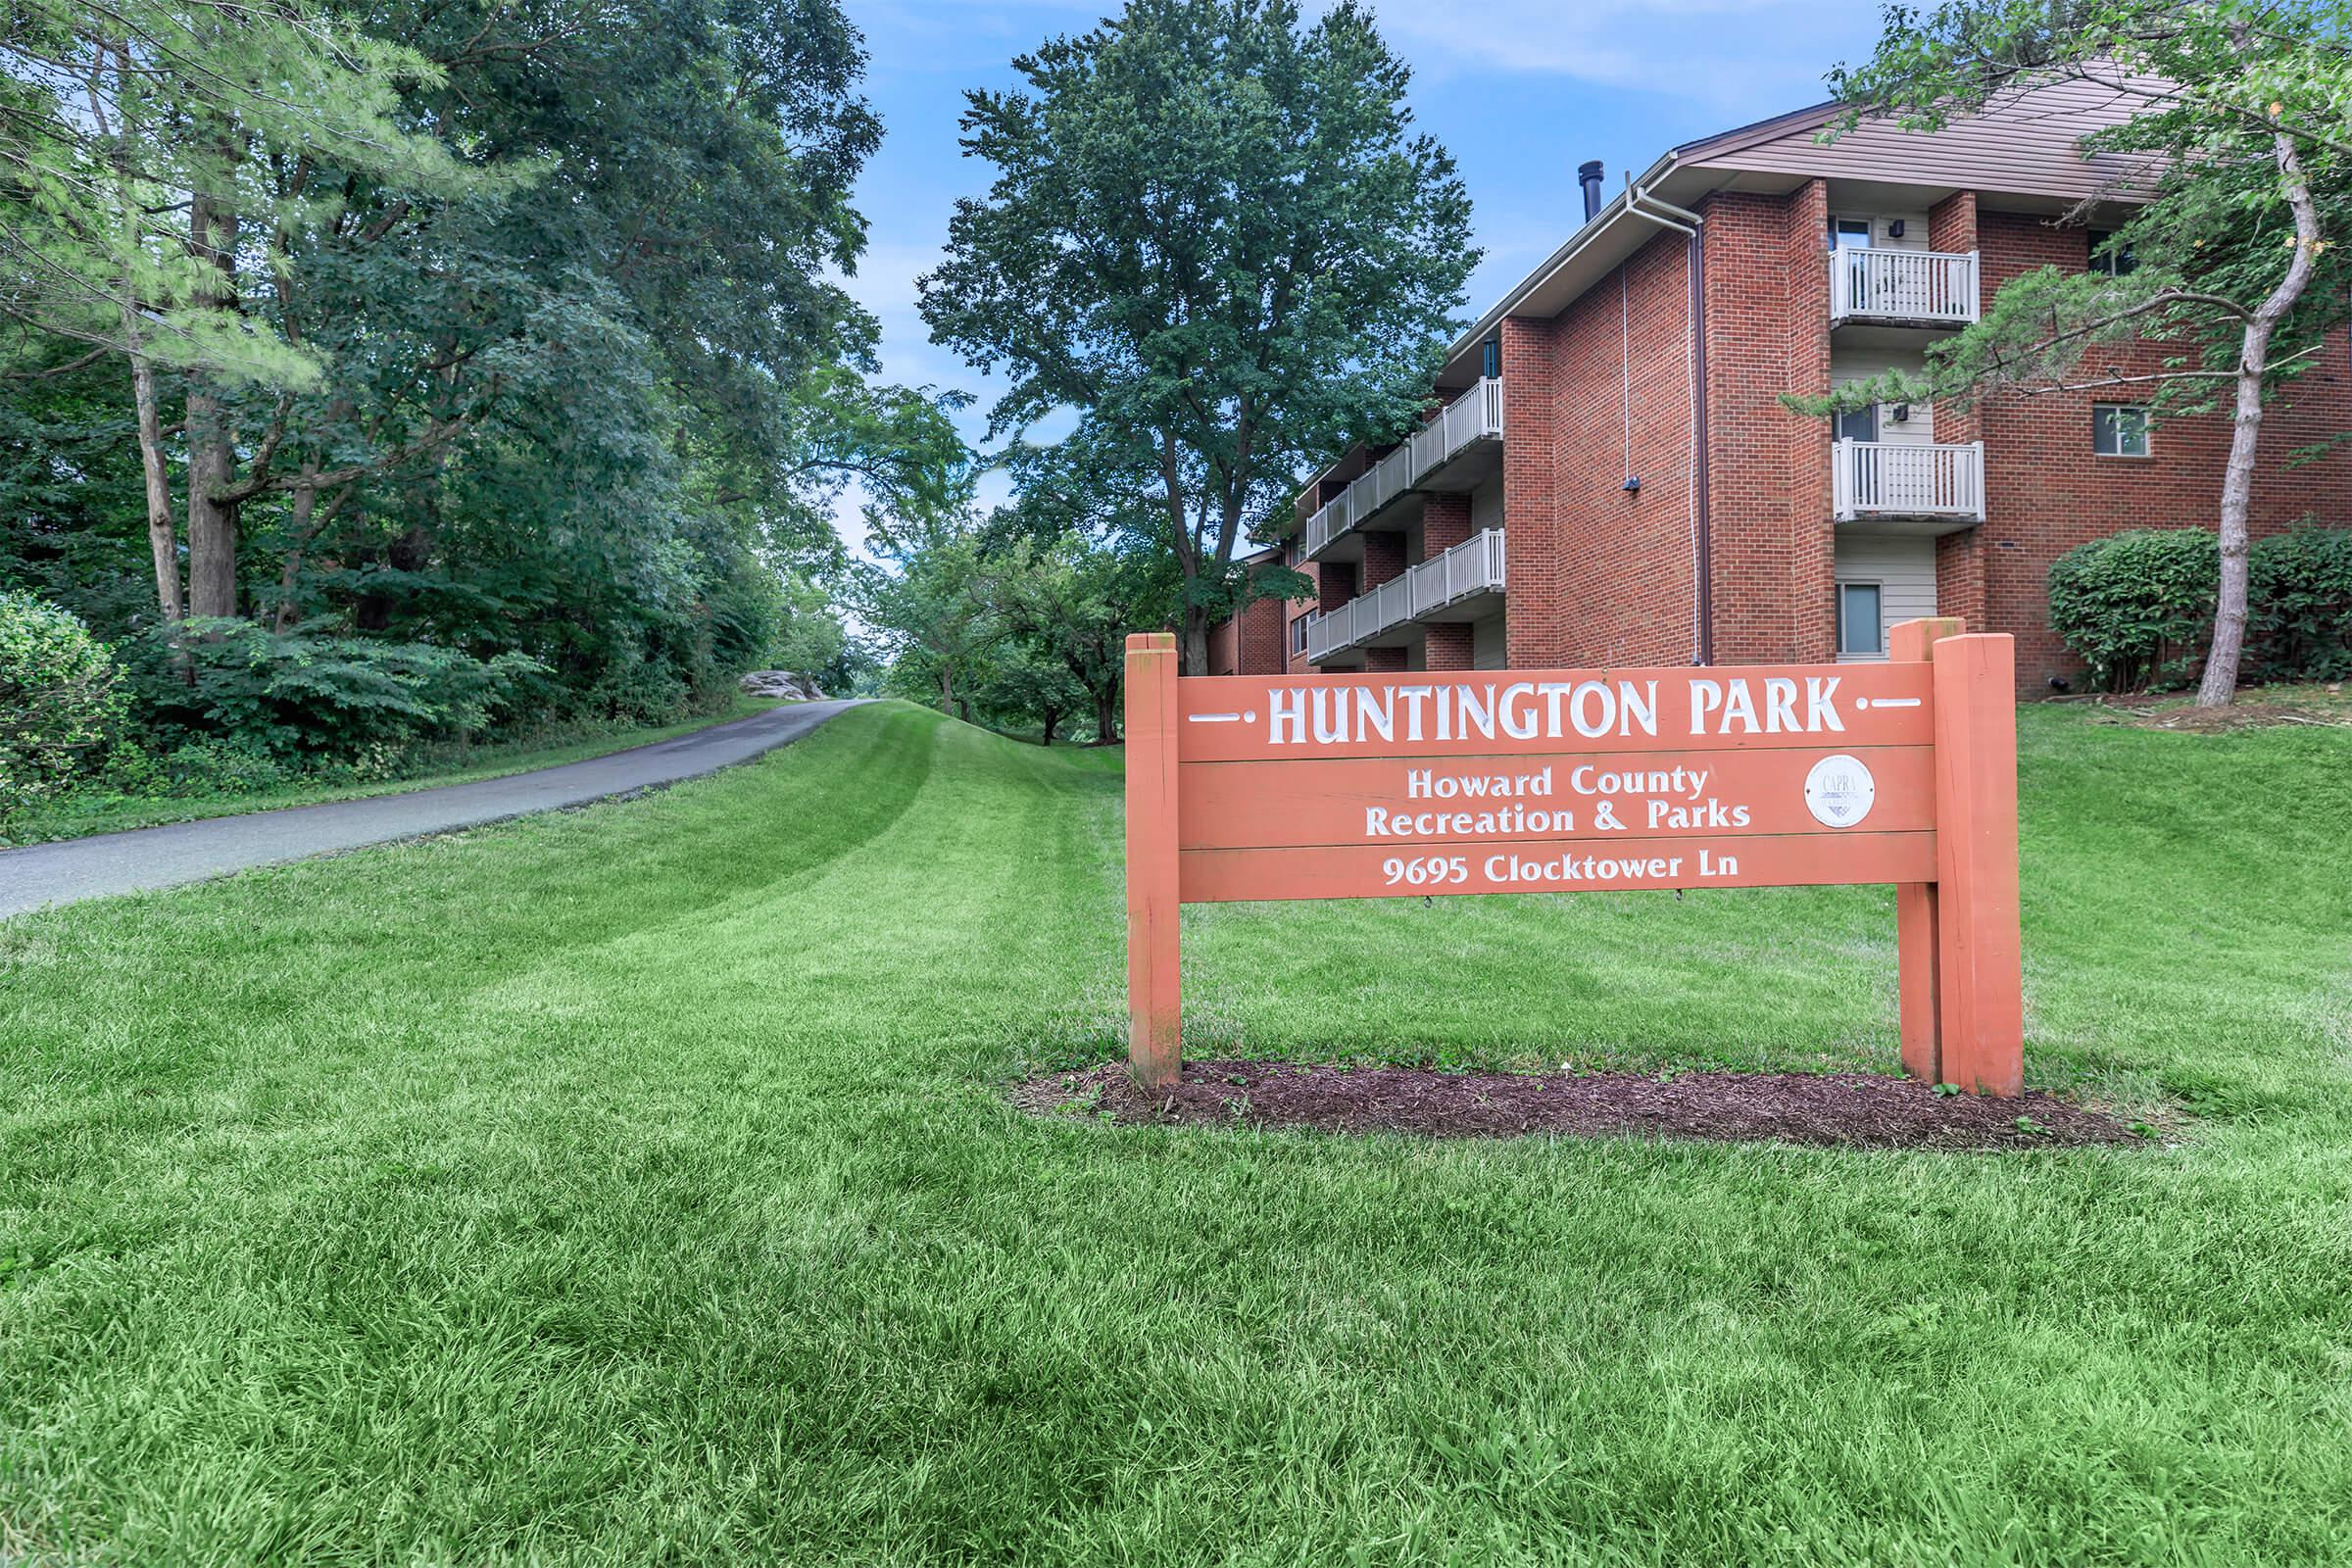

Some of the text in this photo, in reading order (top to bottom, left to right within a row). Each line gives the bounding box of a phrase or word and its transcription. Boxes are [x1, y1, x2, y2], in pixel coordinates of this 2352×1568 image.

[1267, 676, 1846, 745] HUNTINGTON PARK
[1407, 764, 1709, 801] Howard County
[1822, 774, 1857, 792] CAPRA
[1365, 797, 1751, 837] Recreation & Parks
[1382, 849, 1739, 886] 9695 Clocktower Ln
